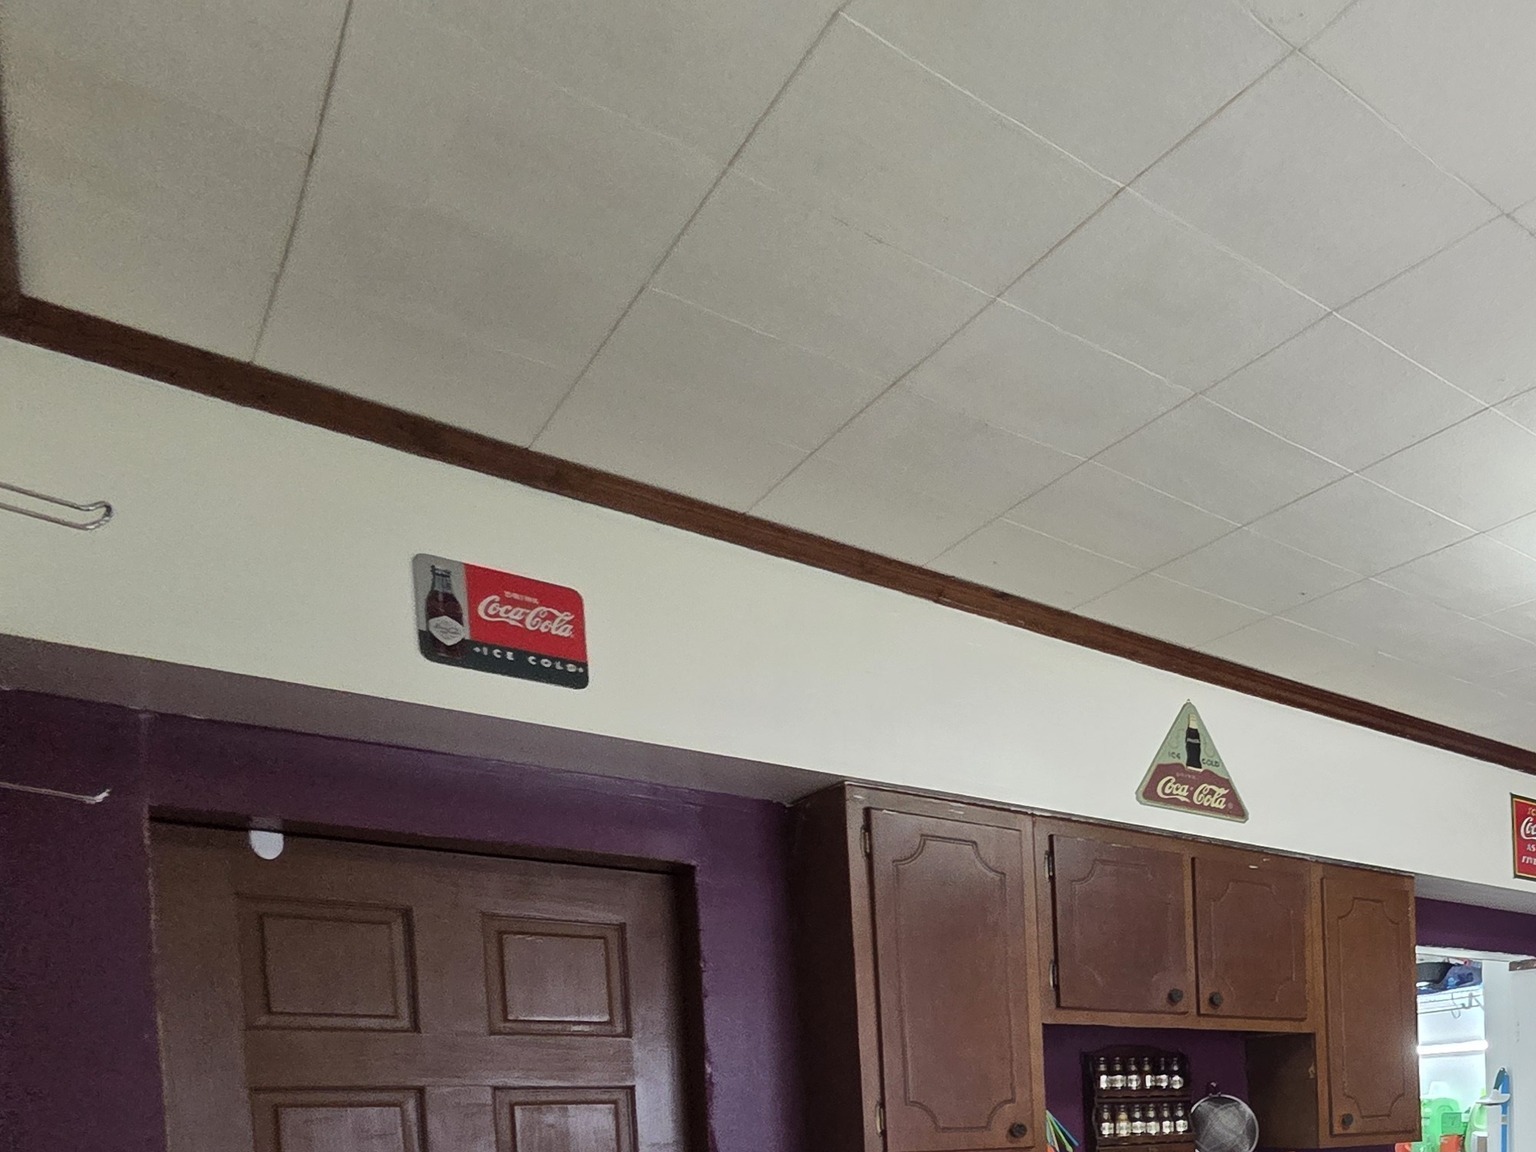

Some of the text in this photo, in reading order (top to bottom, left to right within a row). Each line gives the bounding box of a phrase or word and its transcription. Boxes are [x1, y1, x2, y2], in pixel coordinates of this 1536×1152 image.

[477, 594, 576, 637] Coca-Cola
[482, 646, 578, 673] ICE COLD
[1526, 843, 1536, 853] AS
